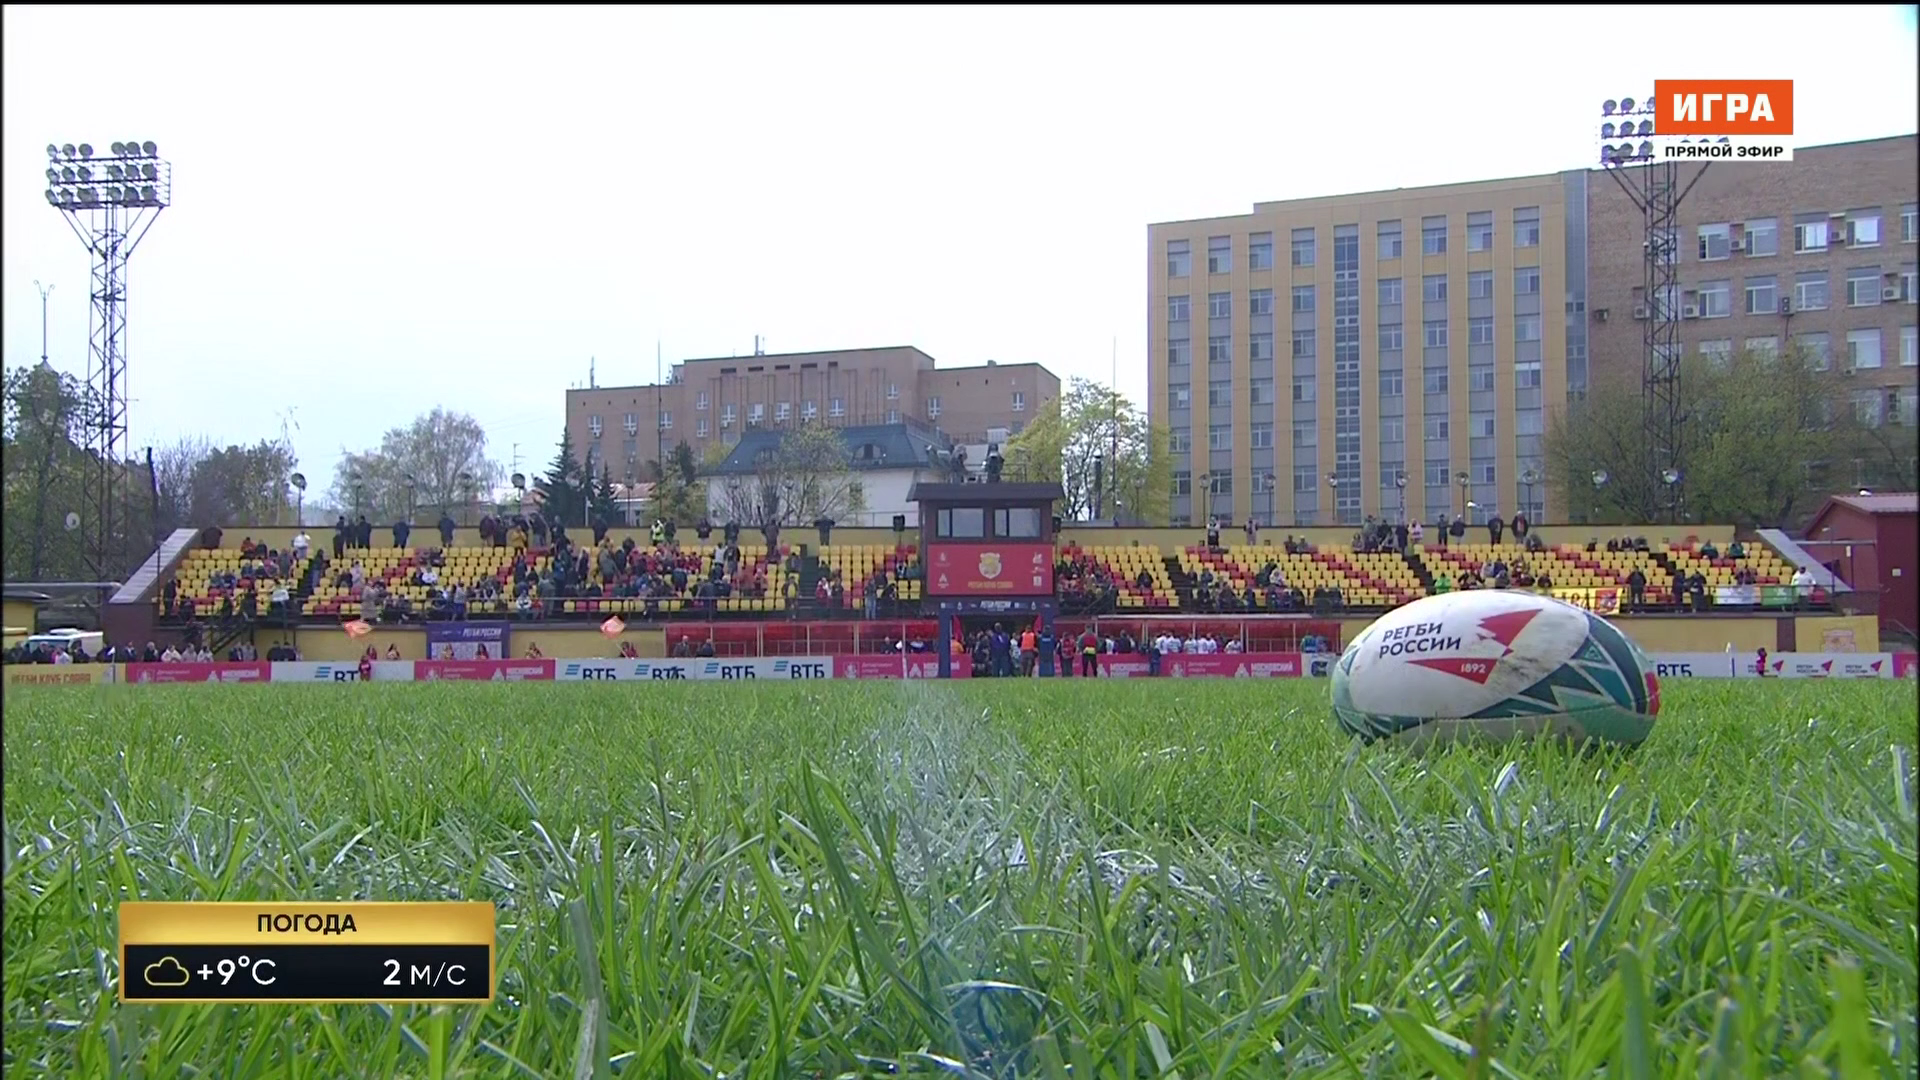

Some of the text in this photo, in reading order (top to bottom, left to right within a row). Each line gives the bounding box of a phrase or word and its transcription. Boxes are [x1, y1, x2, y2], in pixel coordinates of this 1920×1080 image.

[1382, 622, 1443, 642] РЕГБИ
[1379, 637, 1461, 658] РОССИИ
[334, 670, 358, 681] ВТ
[582, 668, 616, 680] ВТБ
[721, 665, 755, 679] ВТБ
[791, 664, 825, 679] ВТБ
[1461, 664, 1486, 674] 1892
[1656, 664, 1692, 677] ВТБ
